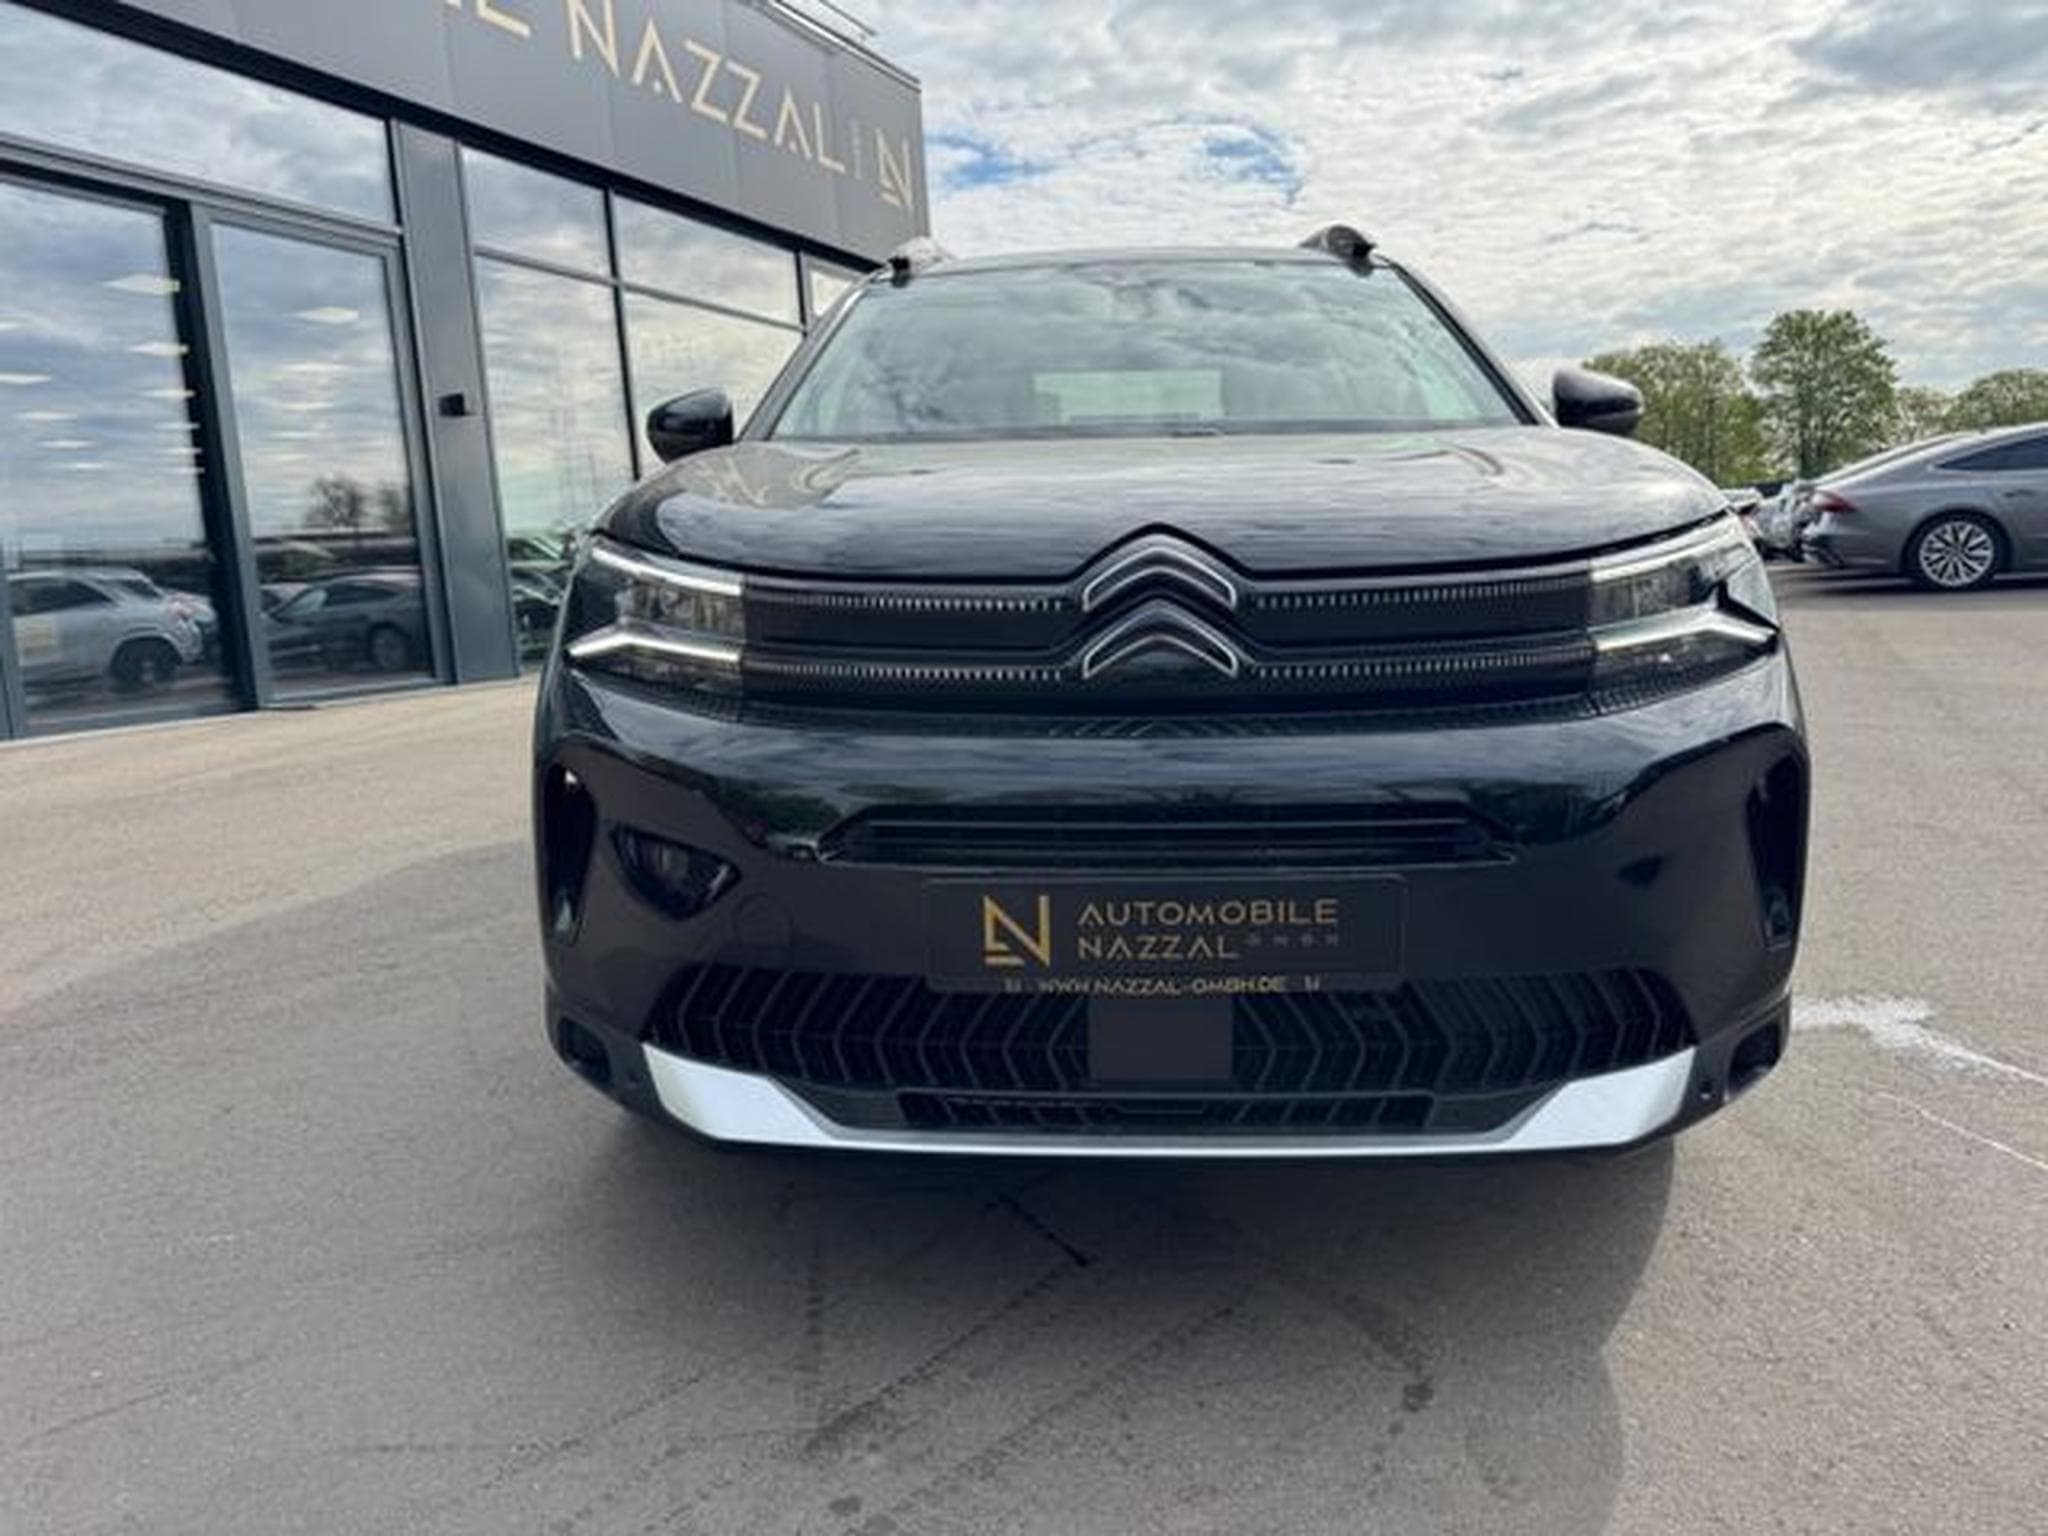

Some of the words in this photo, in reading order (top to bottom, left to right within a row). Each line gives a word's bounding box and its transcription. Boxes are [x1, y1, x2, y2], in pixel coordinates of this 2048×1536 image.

[566, 0, 845, 172] NAZZAL
[1078, 899, 1338, 926] AUTOMOBILE
[1078, 935, 1240, 960] NAZZAL
